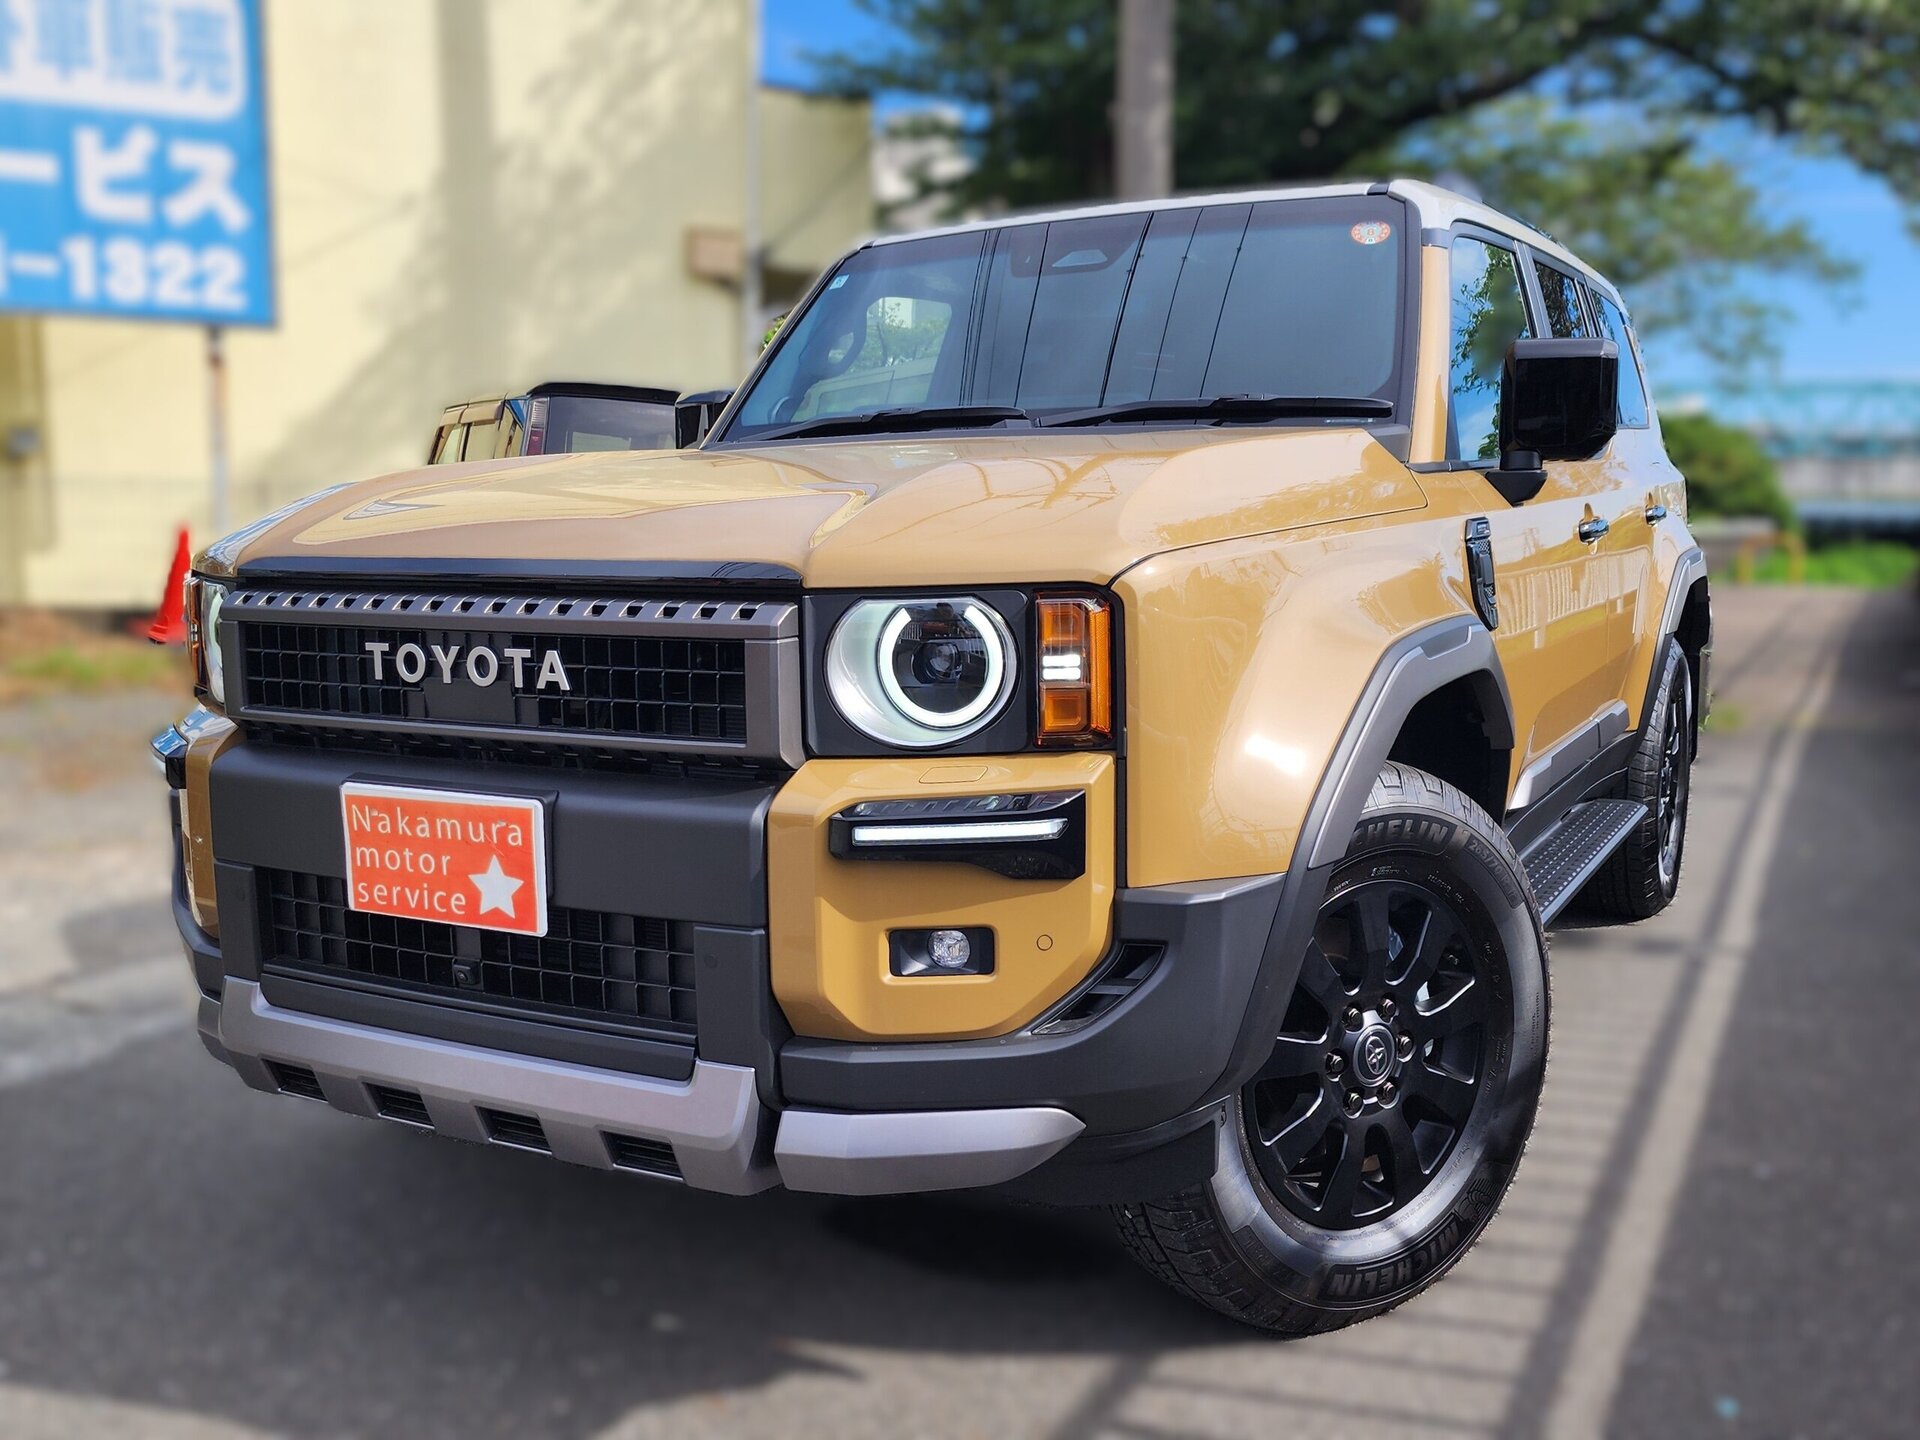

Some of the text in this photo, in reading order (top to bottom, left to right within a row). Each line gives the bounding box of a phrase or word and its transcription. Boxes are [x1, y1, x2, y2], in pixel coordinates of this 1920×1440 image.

[0, 235, 249, 312] -1322
[365, 642, 570, 691] TOYOTA
[351, 803, 523, 847] Nakamura
[1351, 819, 1449, 846] CHELIN
[356, 847, 451, 876] motor
[357, 881, 466, 915] service
[1330, 1222, 1460, 1297] MICHELIN
